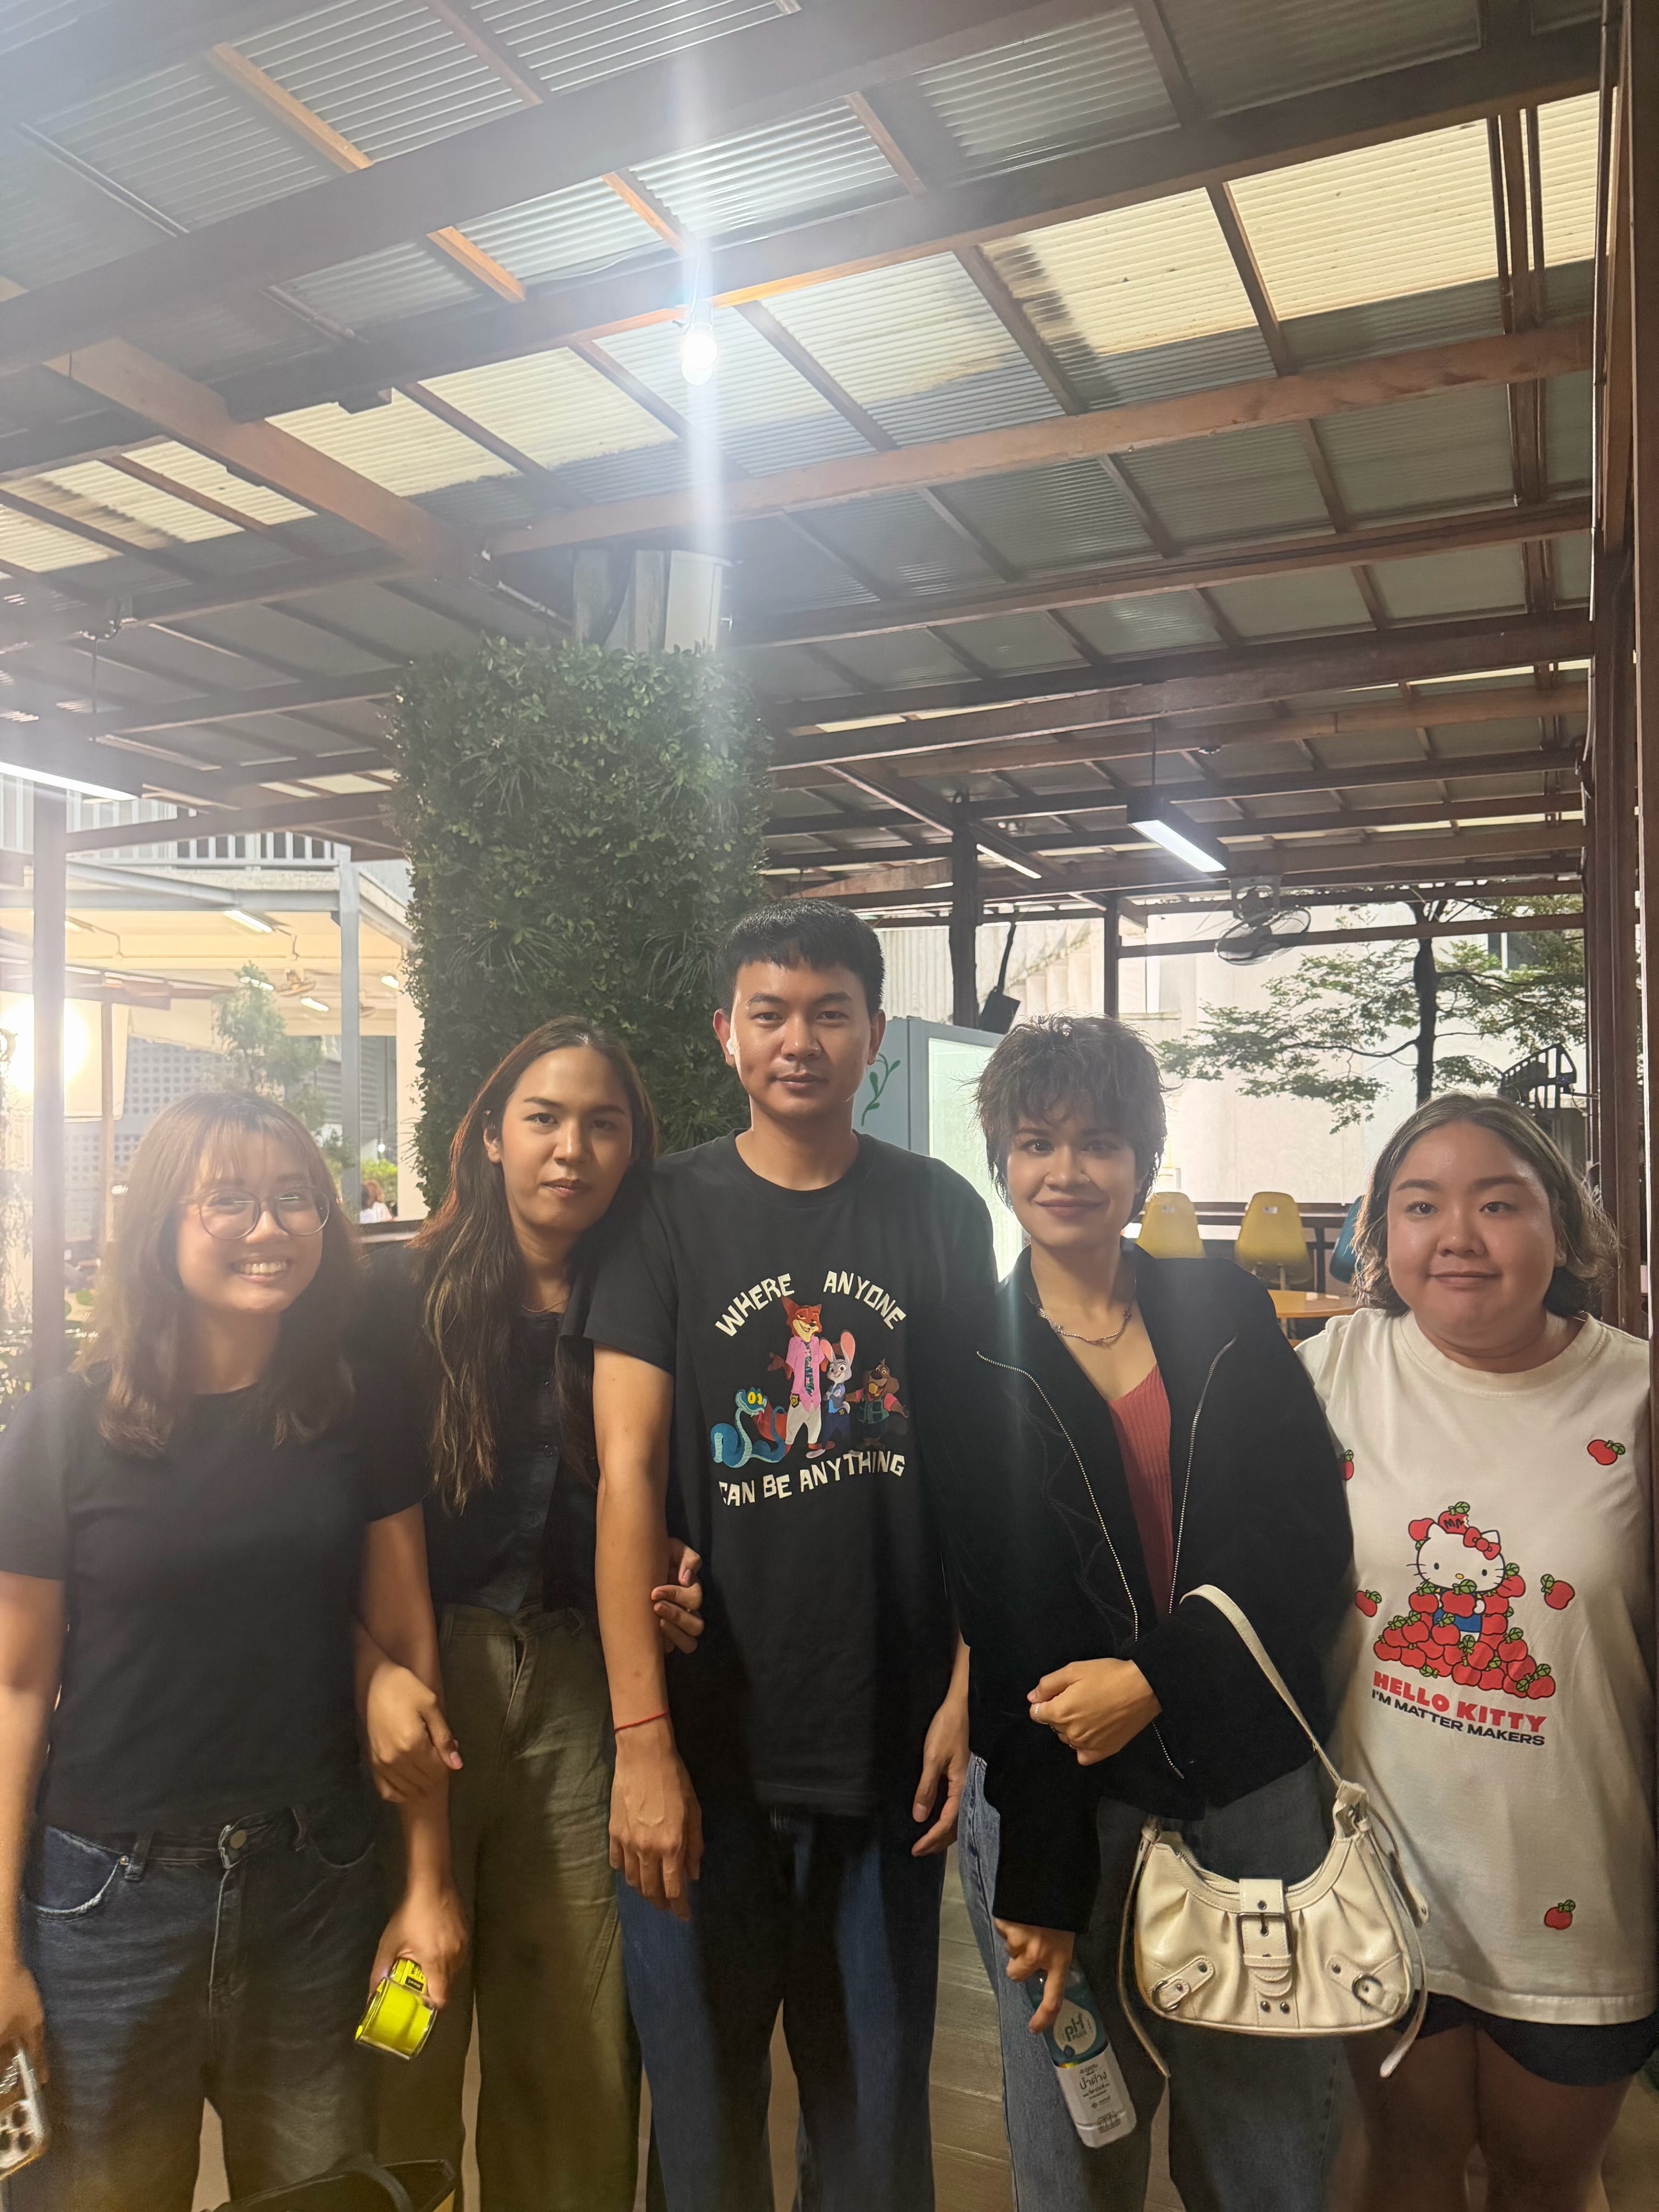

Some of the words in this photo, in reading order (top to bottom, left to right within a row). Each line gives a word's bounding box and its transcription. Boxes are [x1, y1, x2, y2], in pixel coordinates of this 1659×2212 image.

[714, 1273, 795, 1337] WHERE
[823, 1270, 907, 1330] ANYONE
[763, 1474, 793, 1499] BE
[799, 1449, 906, 1493] ANYTHING
[1371, 1689, 1392, 1706] I'M
[1394, 1699, 1464, 1732] MATTER
[1467, 1723, 1546, 1746] MAKERS
[1373, 1670, 1450, 1712] HELLO
[1456, 1701, 1547, 1733] KITTY
